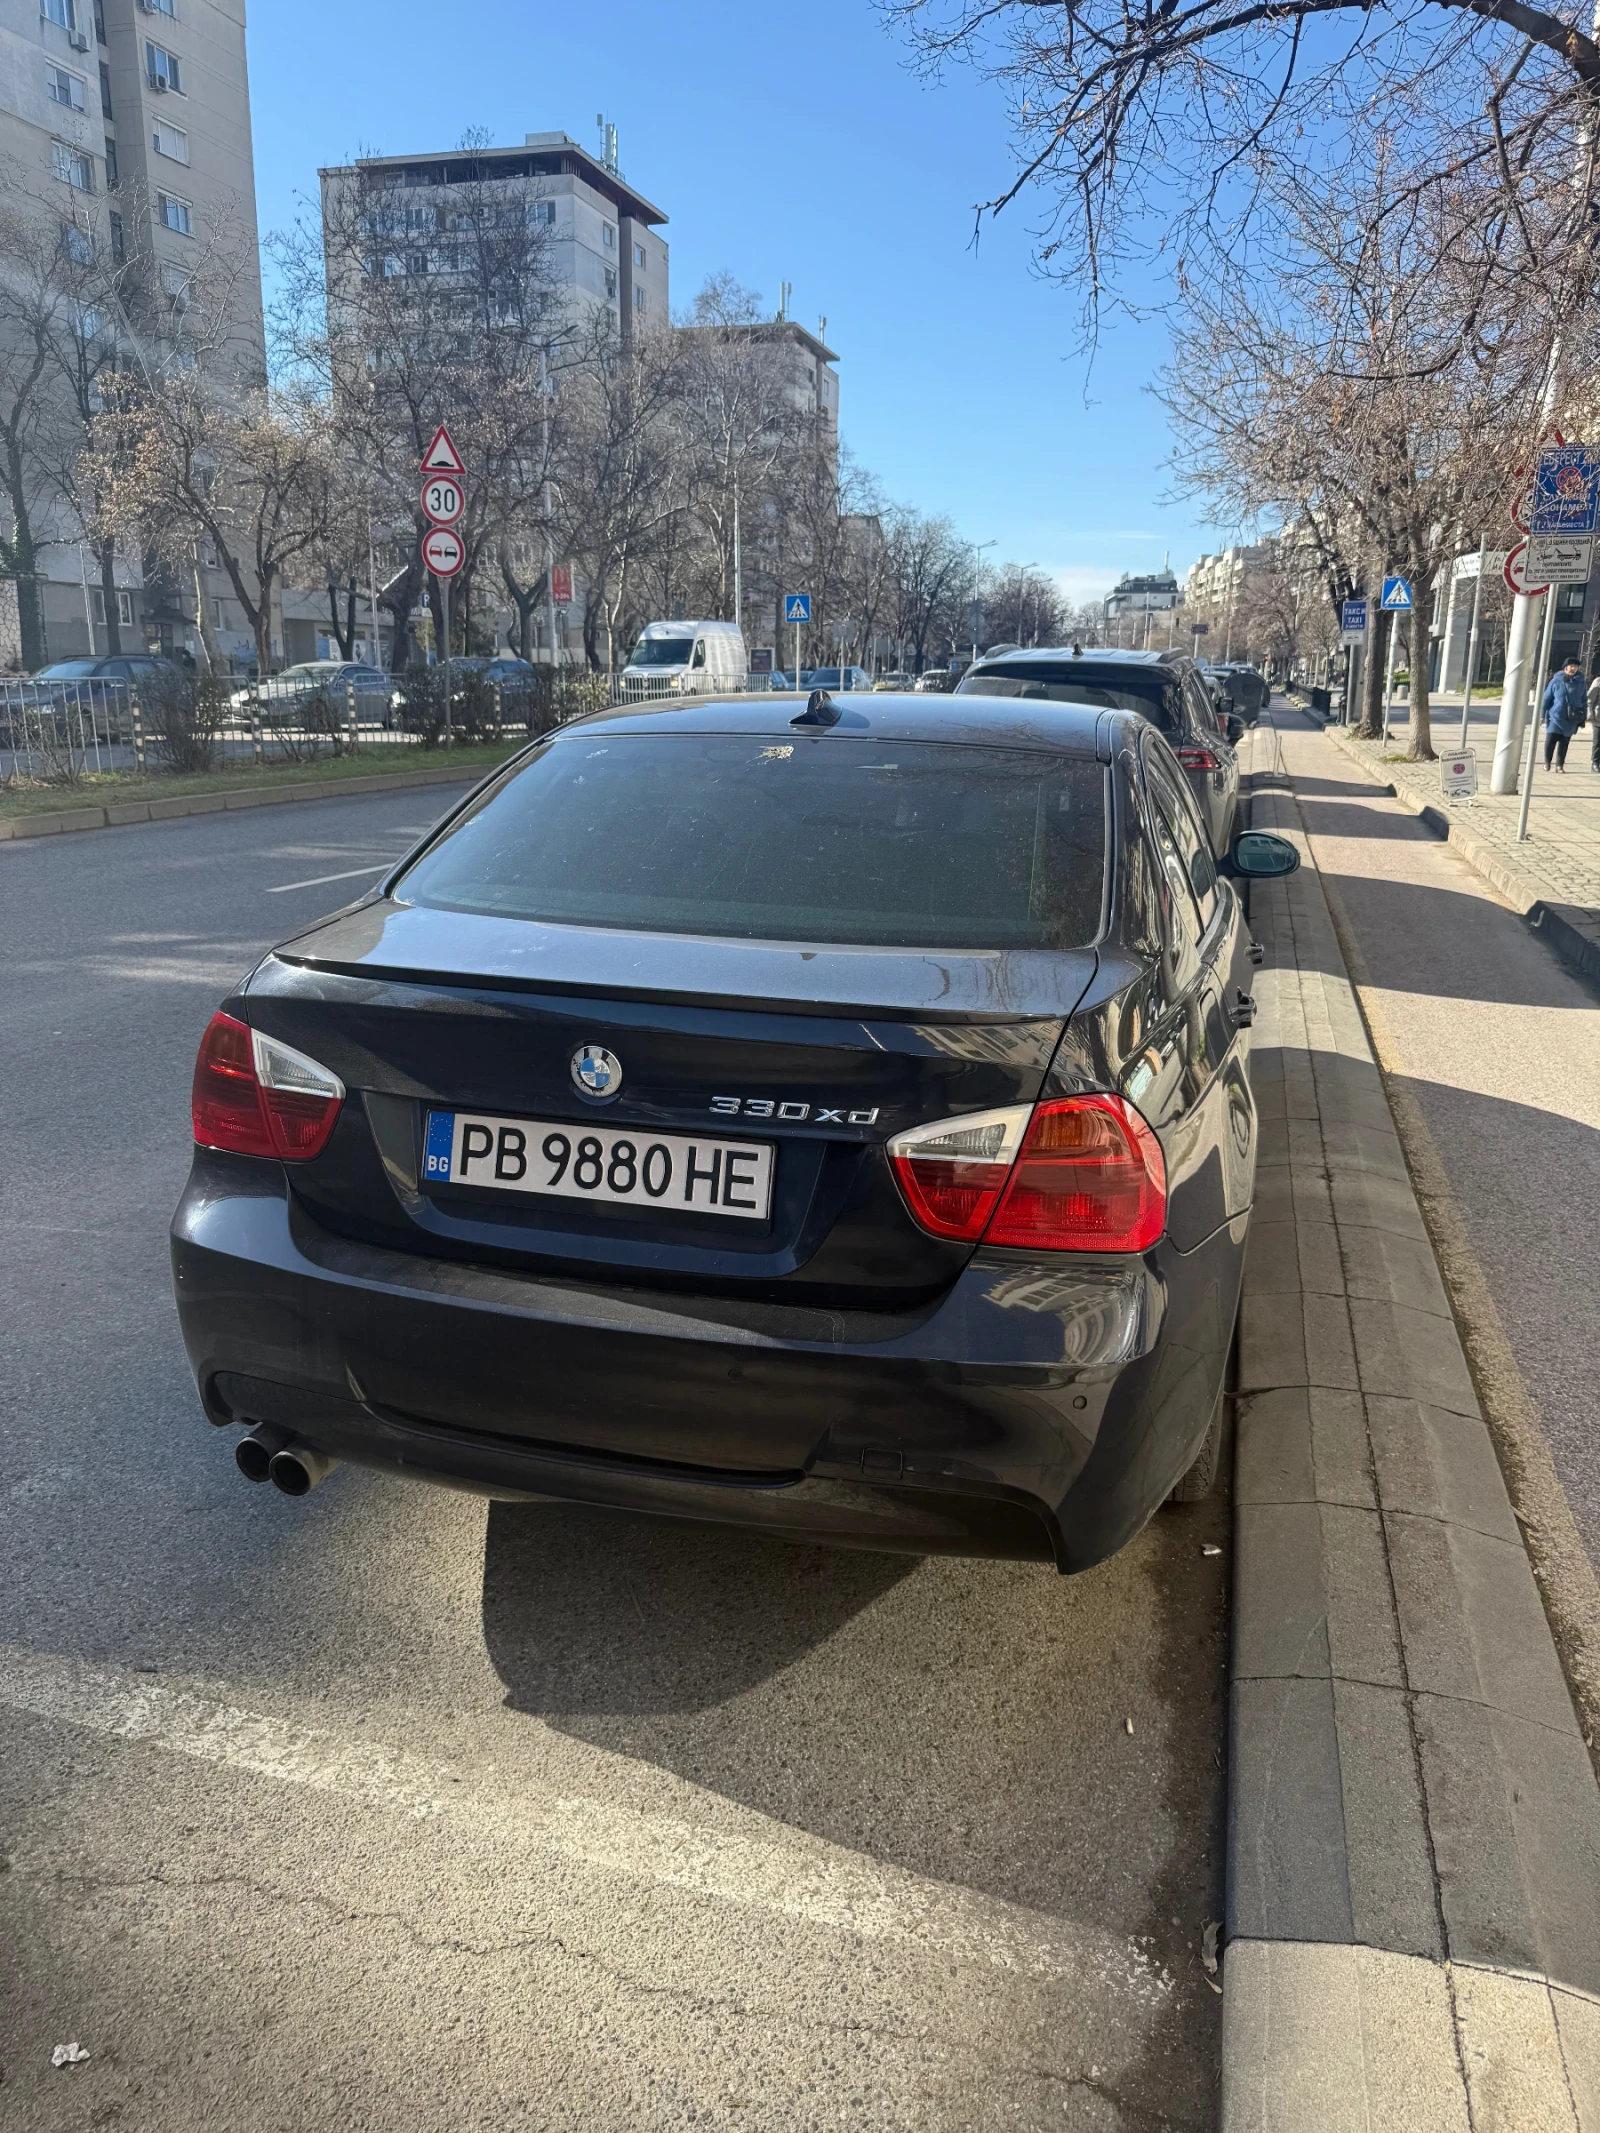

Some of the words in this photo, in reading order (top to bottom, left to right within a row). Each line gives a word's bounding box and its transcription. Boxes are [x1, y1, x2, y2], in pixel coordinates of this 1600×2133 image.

[430, 487, 455, 513] 30
[423, 594, 430, 607] P
[1344, 607, 1366, 615] ТАКСИ
[1348, 616, 1362, 624] TAXI
[427, 1154, 449, 1173] BG
[459, 1123, 528, 1182] PB
[541, 1133, 673, 1198] 9880
[684, 1146, 759, 1210] HE
